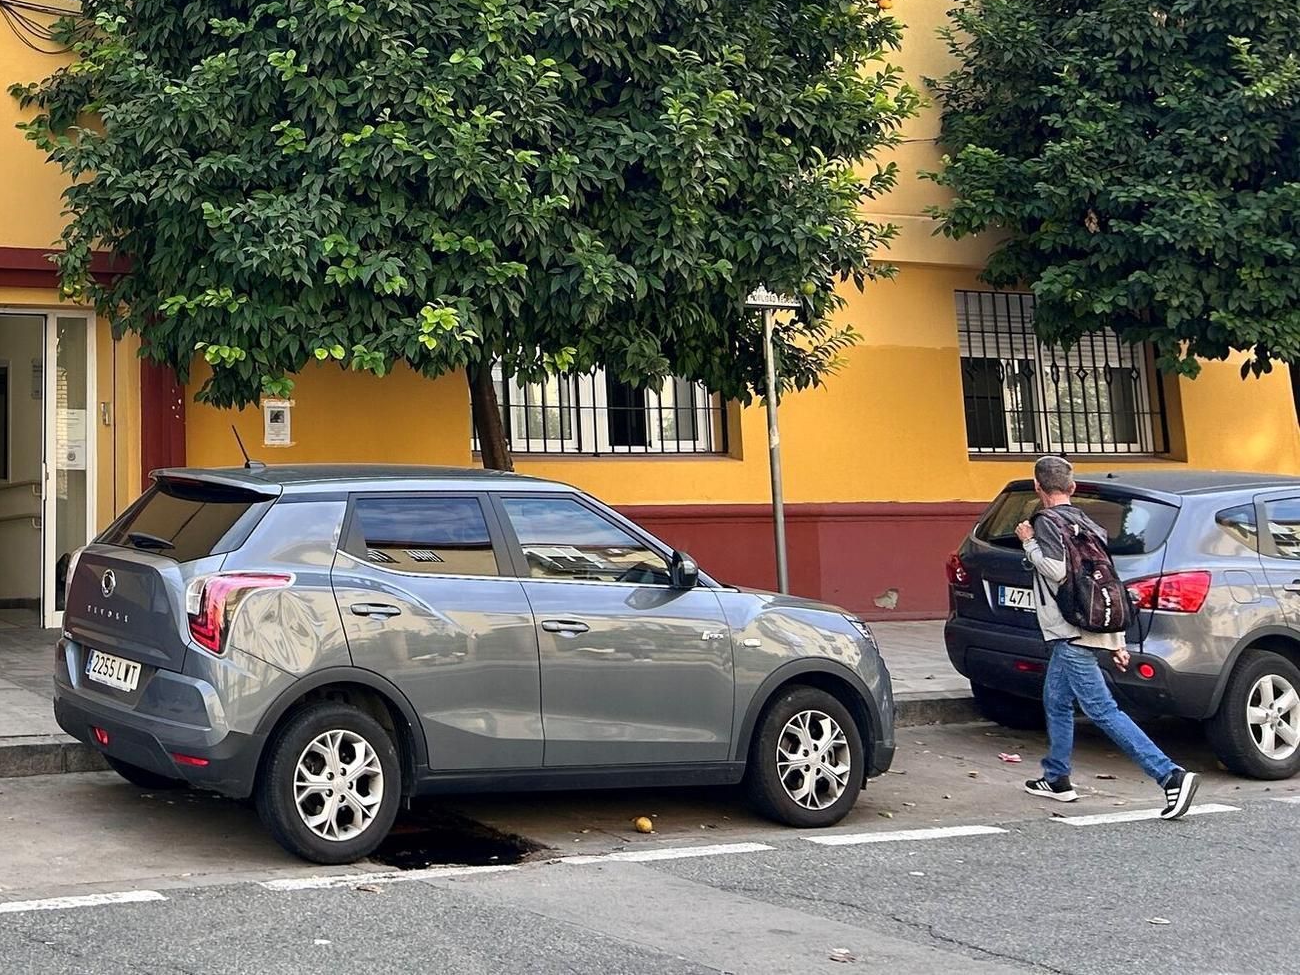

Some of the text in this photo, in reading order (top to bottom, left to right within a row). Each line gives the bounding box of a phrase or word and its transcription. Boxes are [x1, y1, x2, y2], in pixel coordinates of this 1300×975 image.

[1009, 589, 1032, 607] 471
[93, 655, 116, 678] 2255
[116, 661, 138, 685] LT
